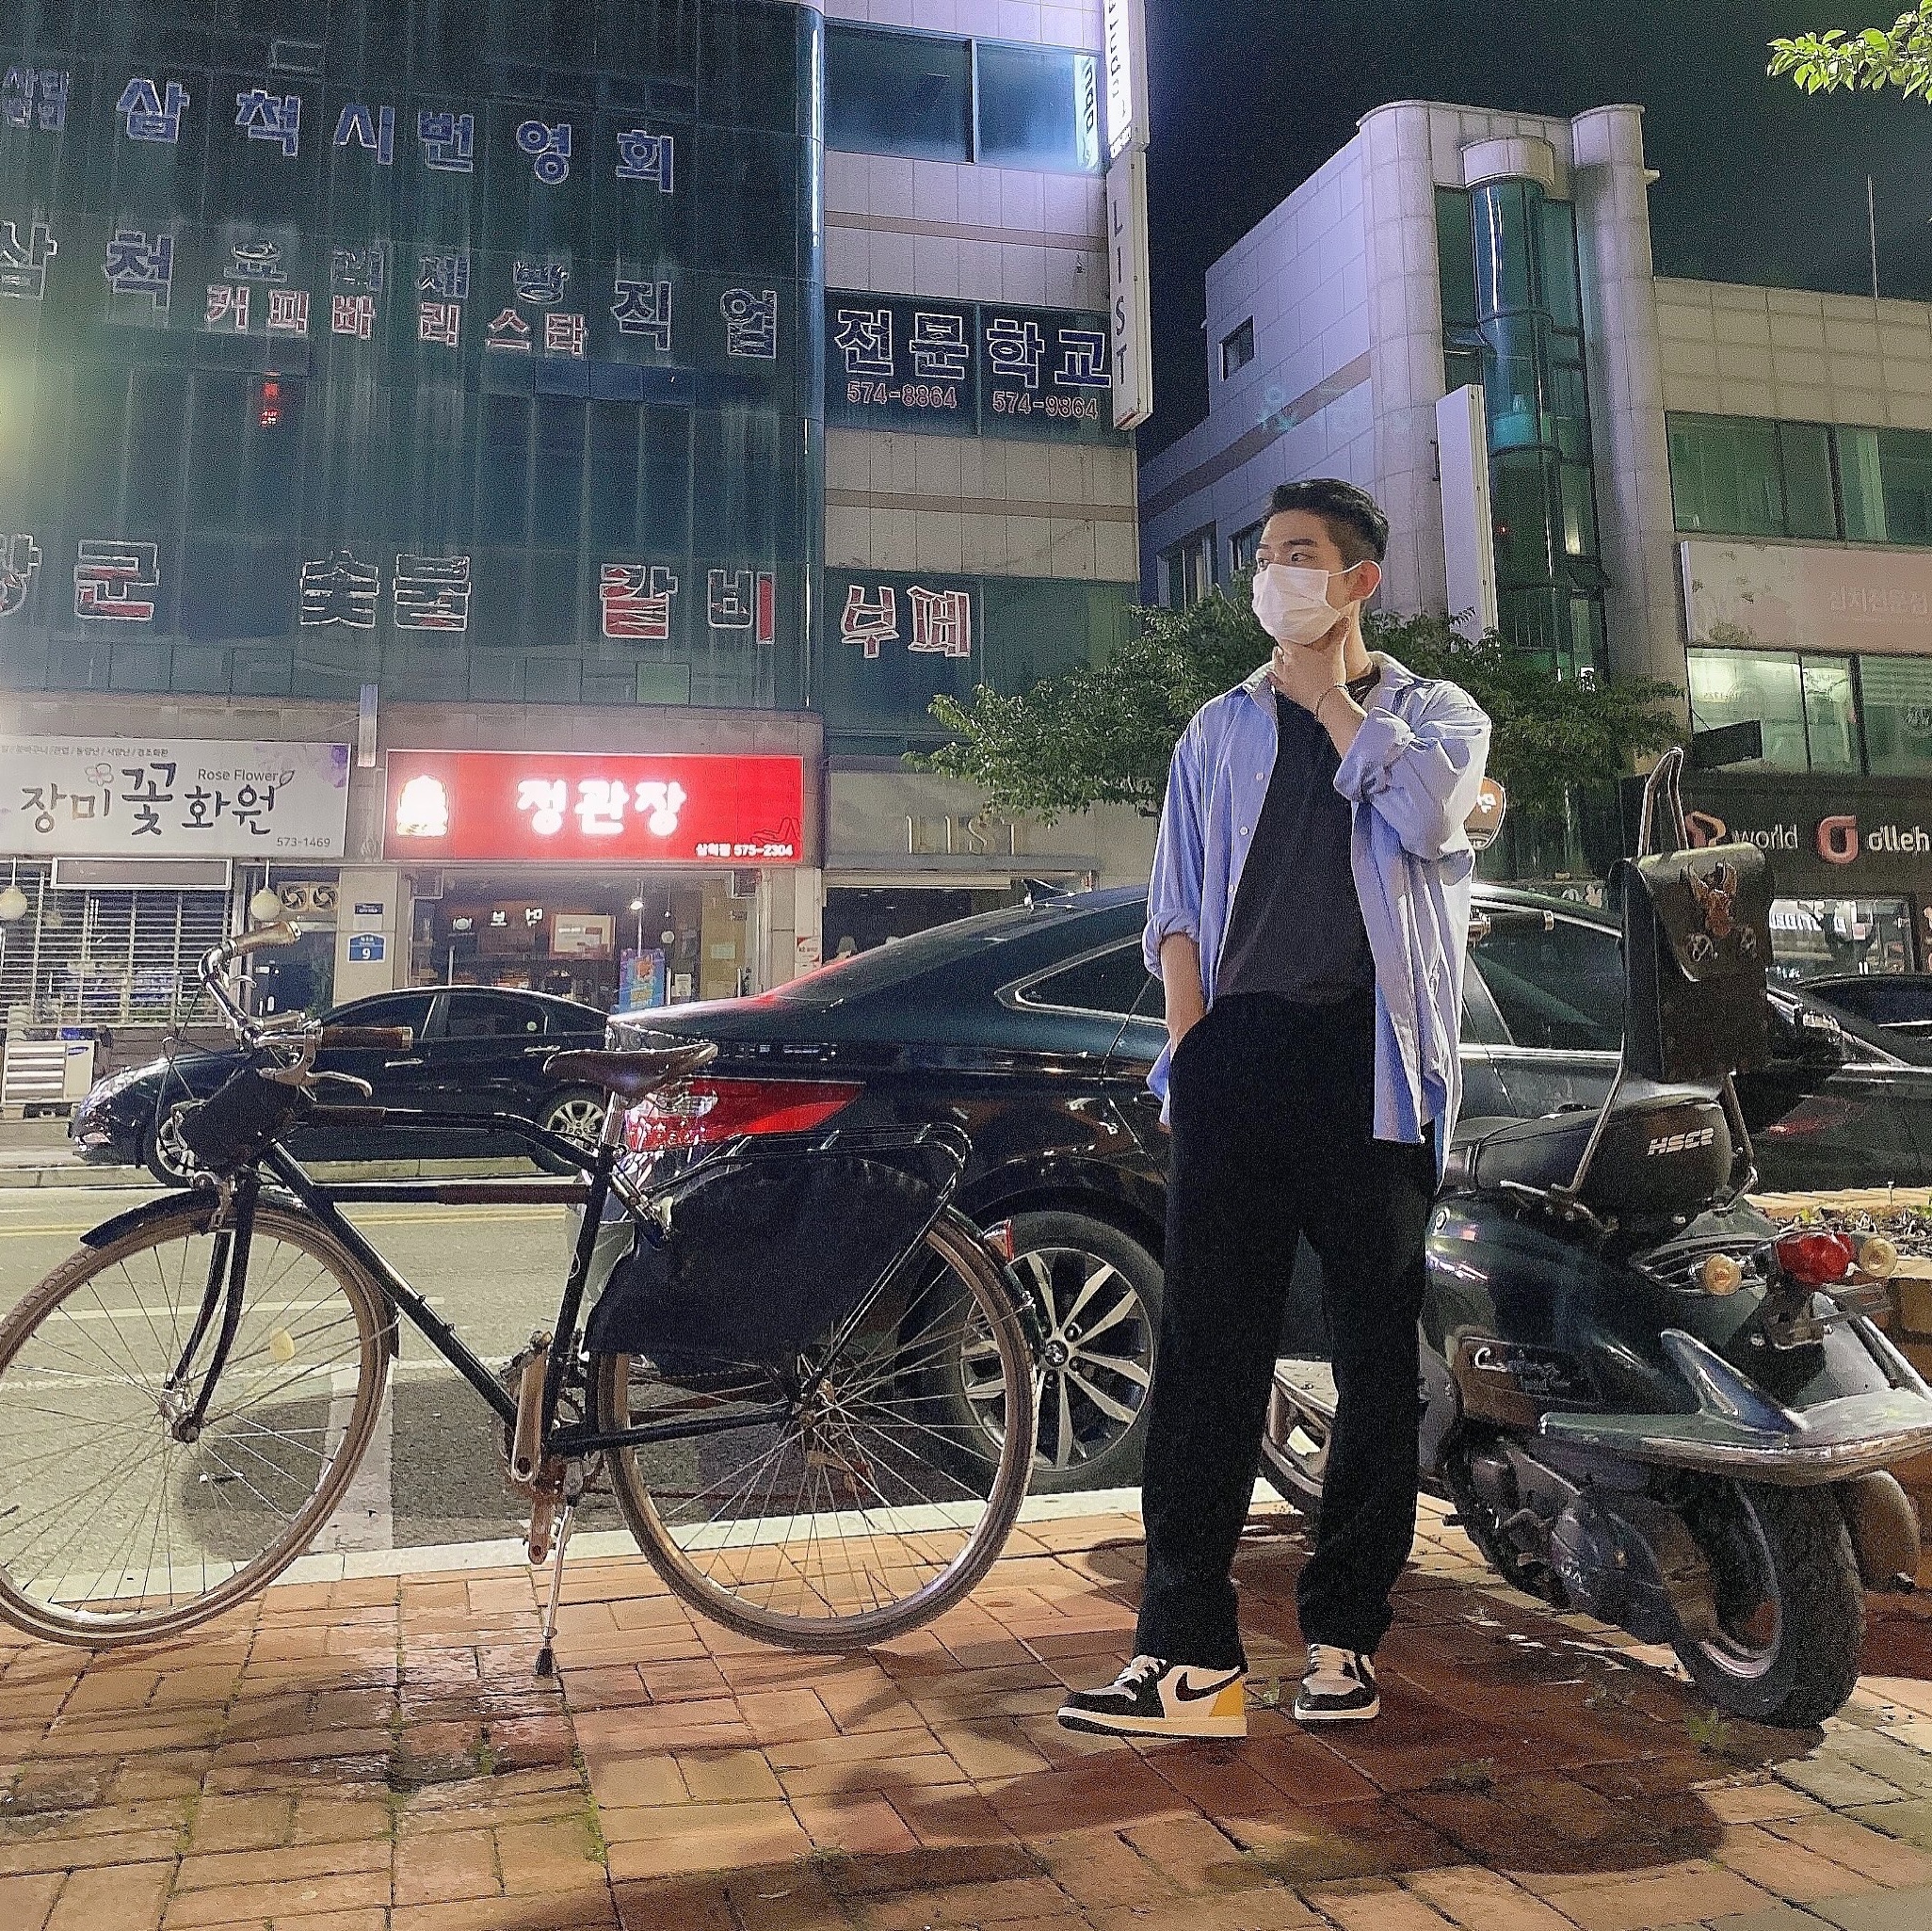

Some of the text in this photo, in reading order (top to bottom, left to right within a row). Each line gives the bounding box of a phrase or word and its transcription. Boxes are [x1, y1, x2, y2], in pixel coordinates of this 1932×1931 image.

[1113, 199, 1128, 385] LIST
[846, 380, 958, 409] 574-8864
[992, 391, 1099, 420] 574-9864
[599, 562, 776, 645] 갈비
[841, 584, 971, 659] 부페
[198, 768, 279, 781] Rose Flower
[516, 778, 687, 837] 정관장
[277, 836, 330, 848] 573-1469
[733, 844, 794, 858] 575-2304
[362, 947, 371, 959] 9
